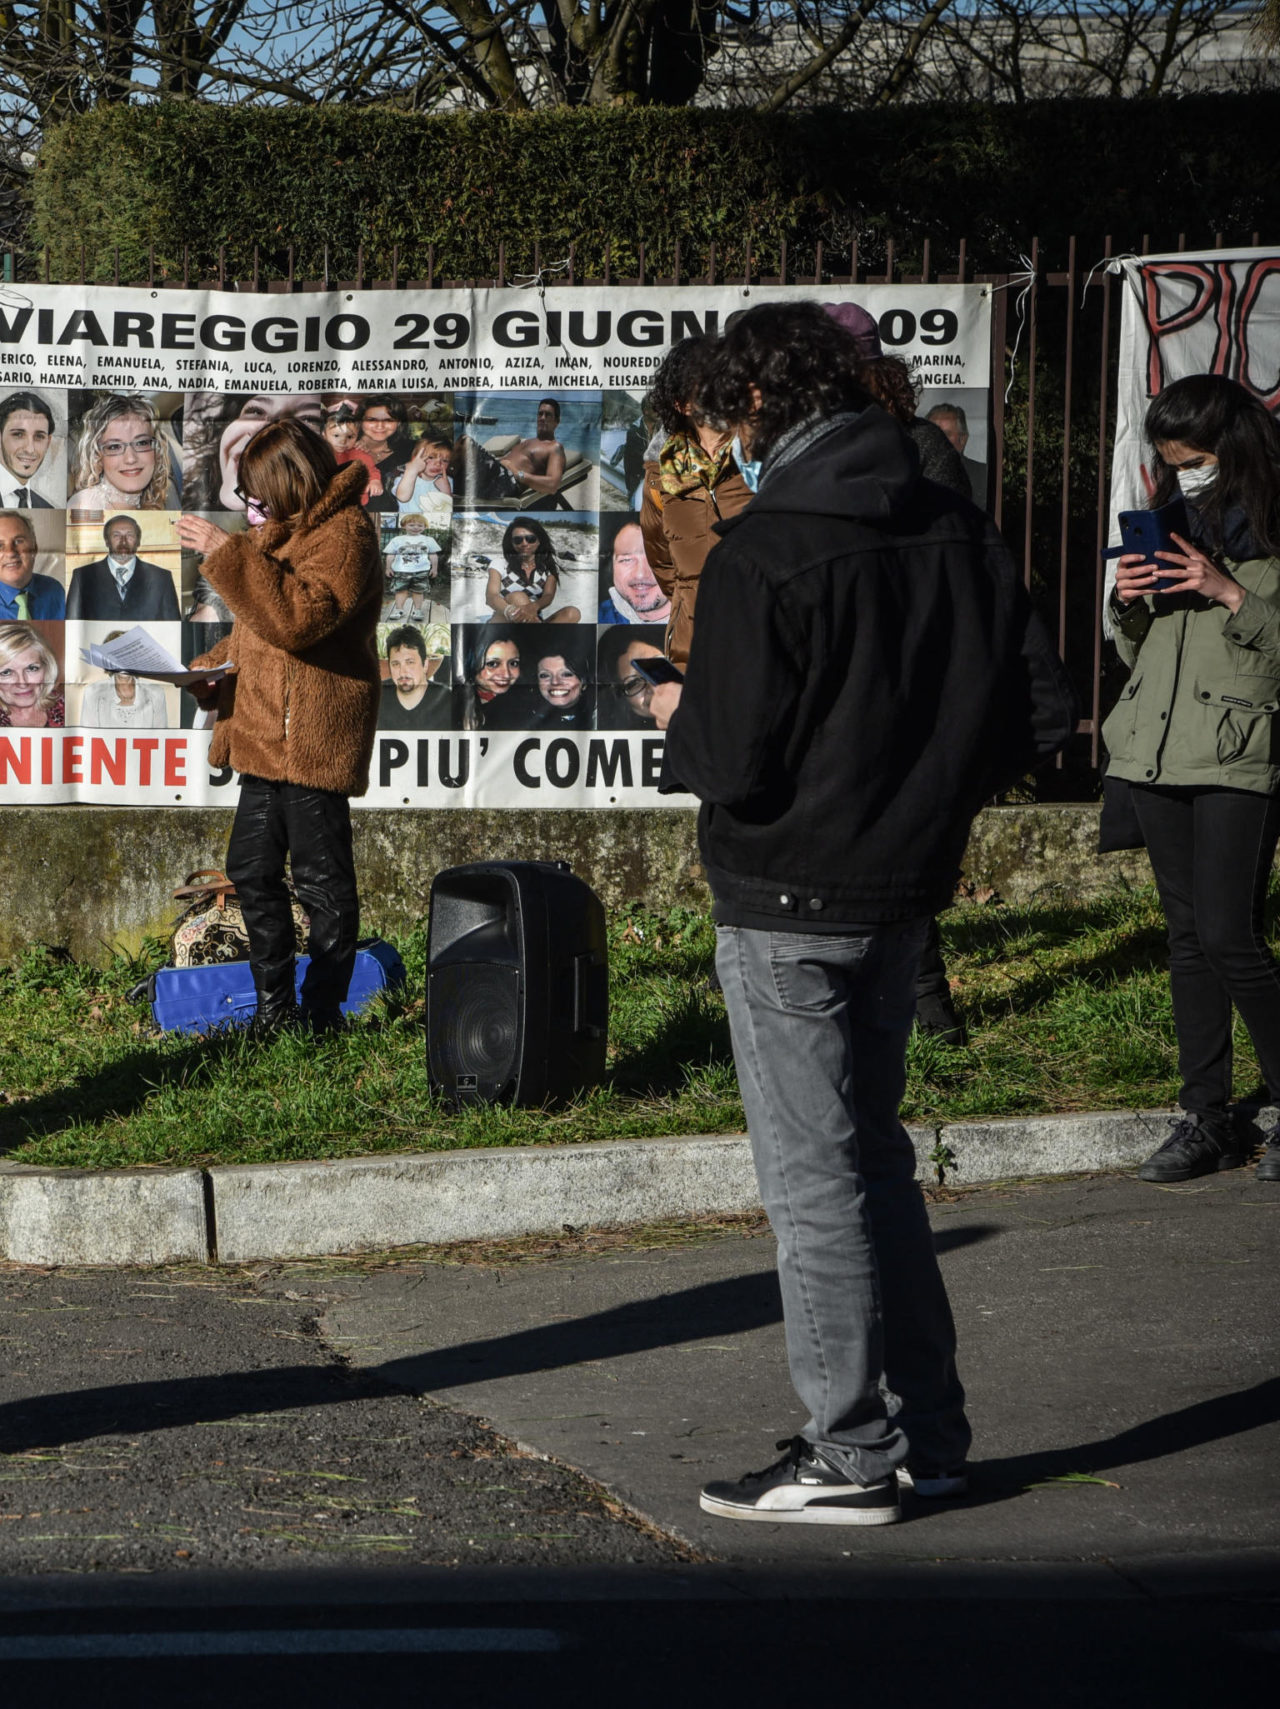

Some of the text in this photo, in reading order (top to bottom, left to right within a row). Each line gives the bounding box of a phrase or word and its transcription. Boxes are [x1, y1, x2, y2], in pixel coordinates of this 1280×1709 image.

[393, 313, 470, 350] 29
[491, 309, 748, 348] GIUGN
[878, 308, 959, 346] 09
[47, 355, 87, 369] ELENA,
[97, 356, 165, 371] EMANUELA,
[176, 359, 234, 374] STEFANIA,
[244, 362, 277, 374] LUCA,
[287, 360, 341, 373] LORENZO,
[351, 359, 429, 372] ALESSANDRO,
[438, 357, 495, 370] ANTONIO,
[505, 357, 545, 370] AZIZA,
[555, 357, 592, 370] IMAN,
[911, 355, 966, 368] MARINA,
[40, 373, 87, 387] HAMZA,
[92, 374, 138, 388] RACHID,
[142, 376, 172, 390] ANA,
[178, 377, 219, 390] NADIA,
[224, 379, 293, 392] EMANUELA,
[298, 378, 351, 392] ROBERTA,
[357, 378, 397, 390] MARIA
[402, 377, 438, 390] LUISA,
[443, 375, 494, 388] ANDREA,
[500, 375, 543, 388] ILARIA,
[548, 375, 603, 388] MICHELA,
[916, 373, 966, 385] ANGELA.
[379, 738, 489, 788] PIU'
[513, 737, 665, 788] COME
